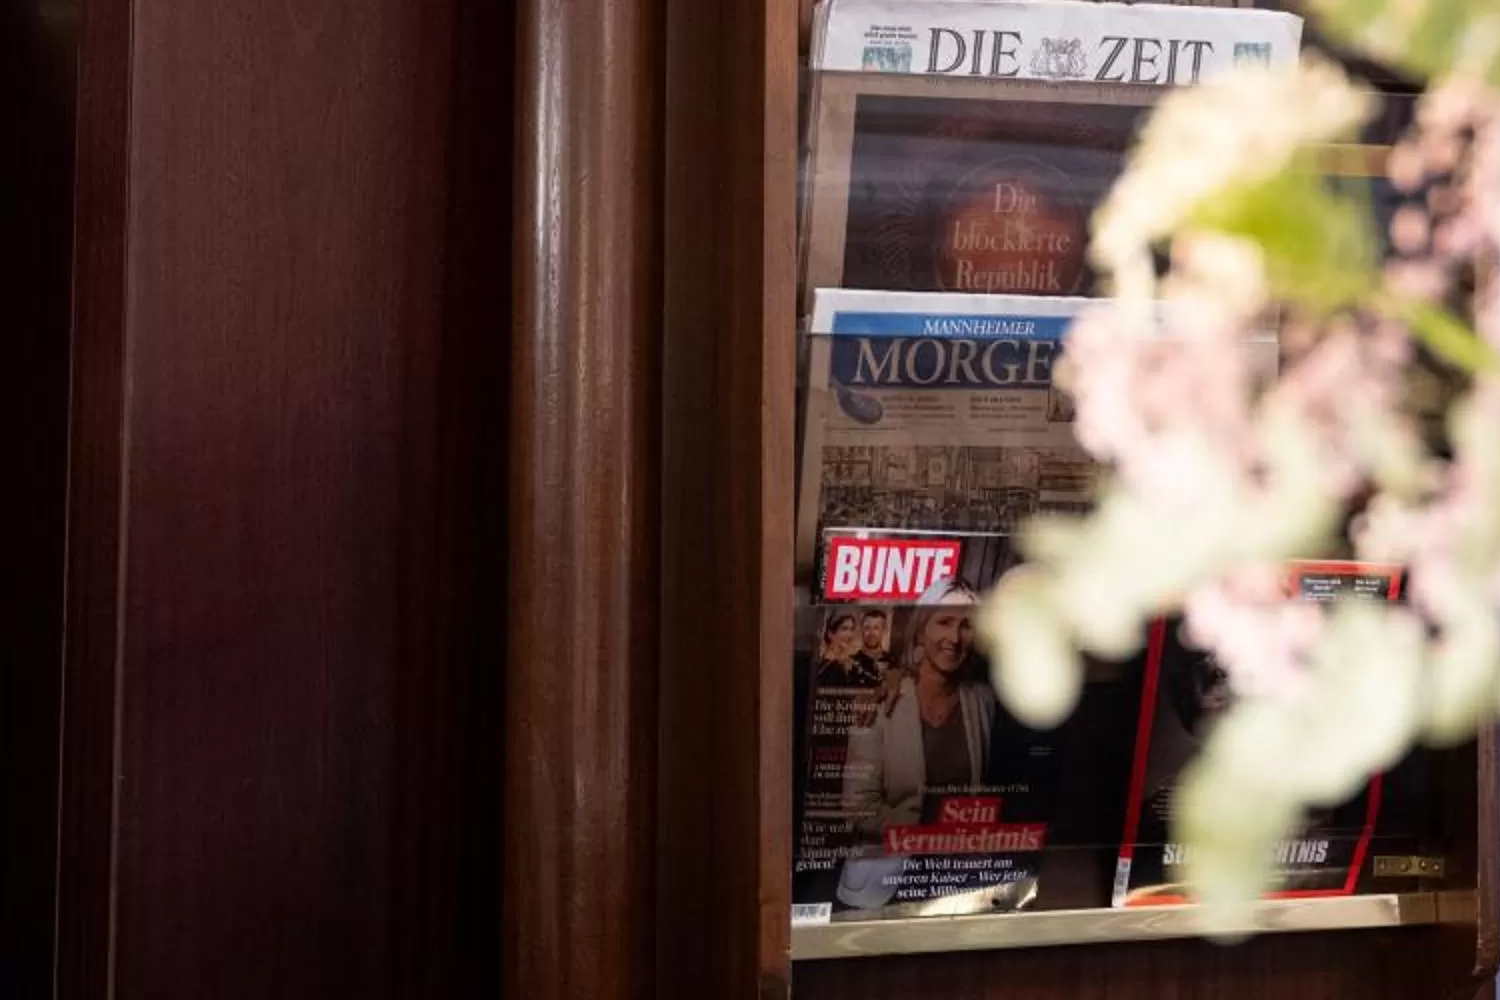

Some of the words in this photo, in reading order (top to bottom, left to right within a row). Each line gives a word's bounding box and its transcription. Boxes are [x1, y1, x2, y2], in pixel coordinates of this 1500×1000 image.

[927, 27, 1023, 77] DIE
[1093, 36, 1215, 85] ZEIT
[994, 183, 1037, 213] Die
[955, 259, 1060, 293] Republik
[923, 318, 1035, 337] MANNHEIMER
[853, 337, 1067, 385] MORGE
[832, 545, 954, 593] BUNTE
[943, 800, 996, 823] Sein
[888, 827, 1041, 852] Vermächtnis
[903, 858, 922, 870] Die
[924, 858, 950, 870] Welt
[897, 888, 928, 898] seine
